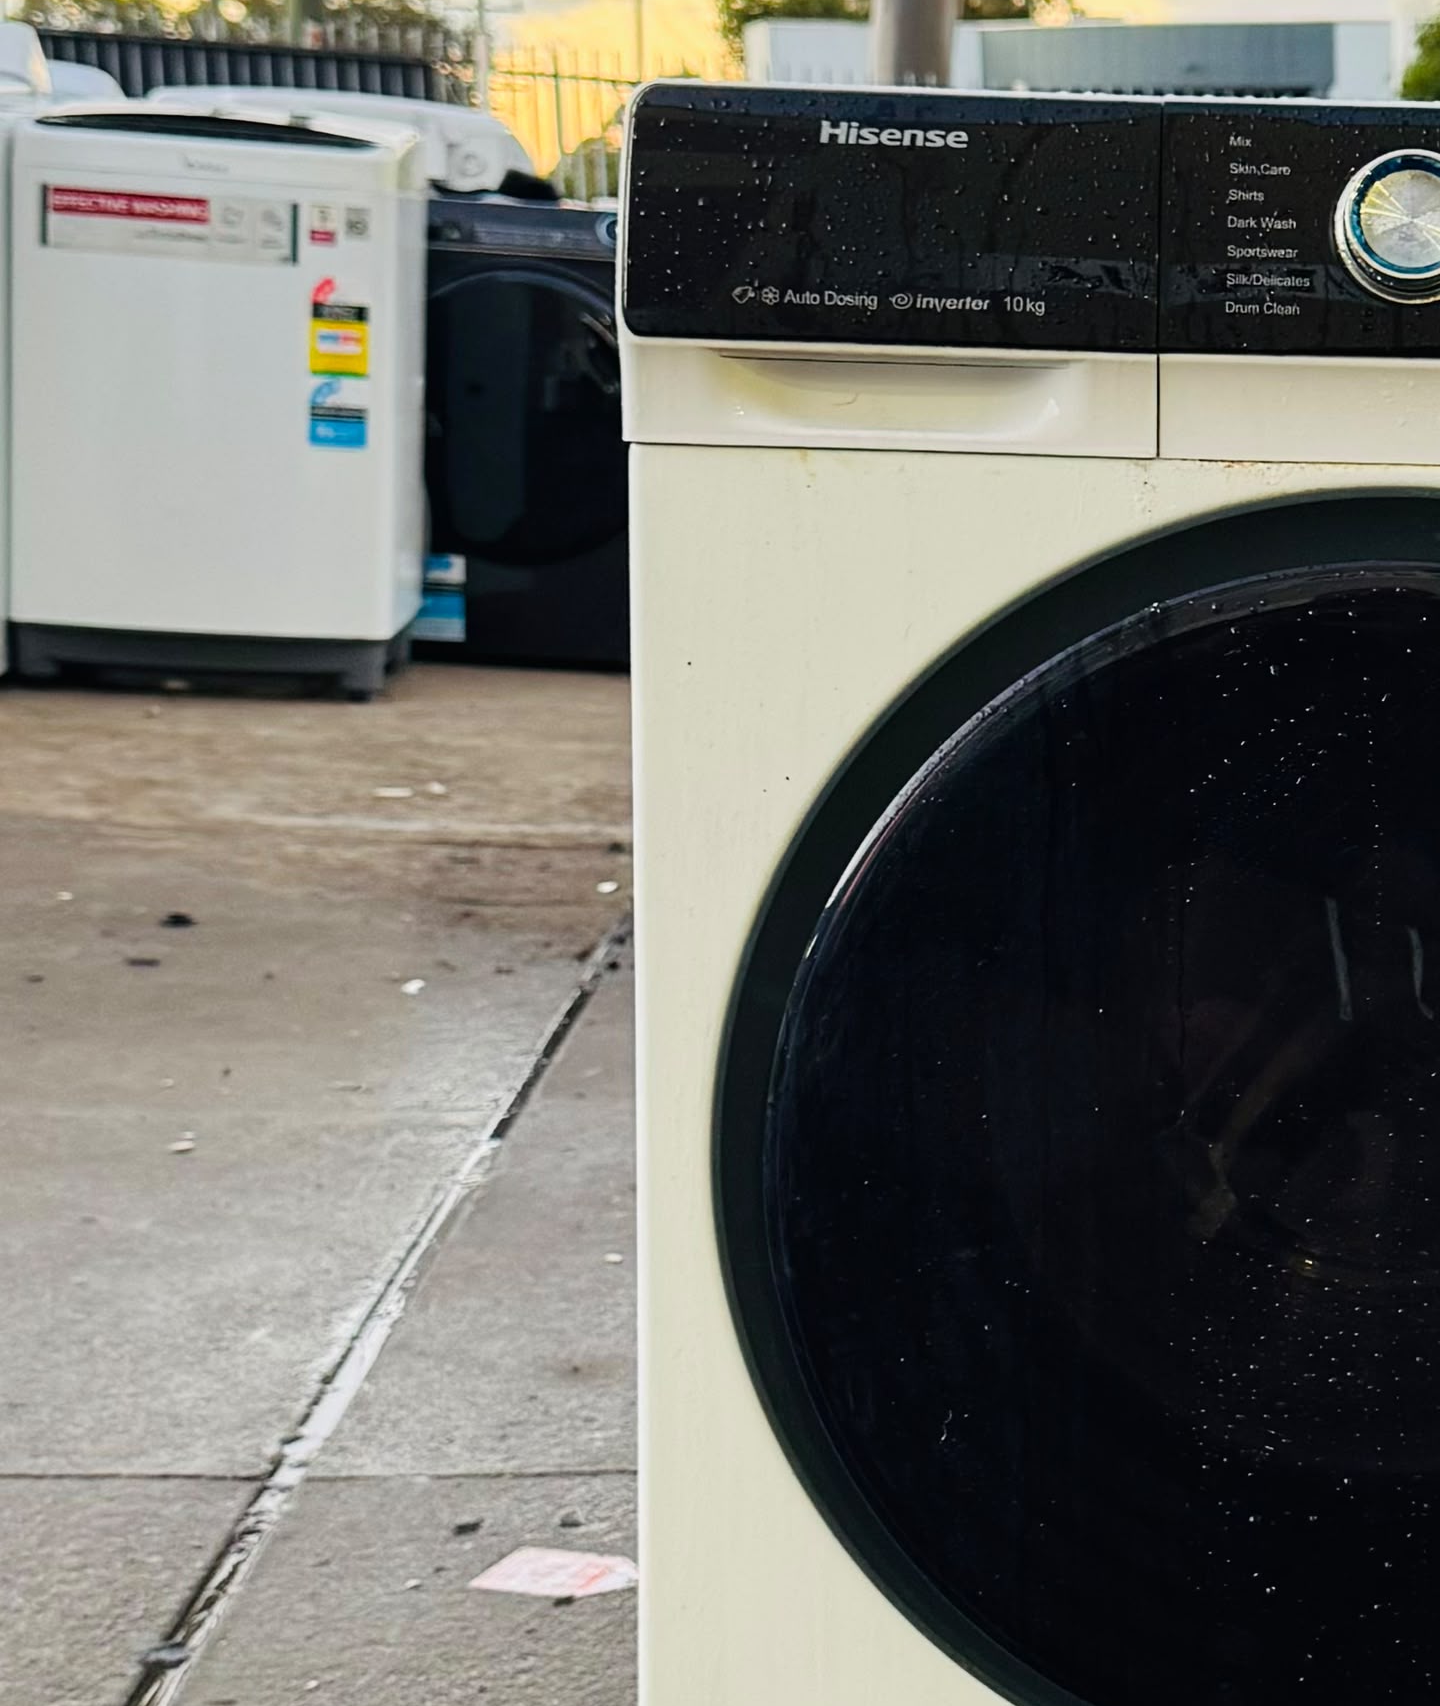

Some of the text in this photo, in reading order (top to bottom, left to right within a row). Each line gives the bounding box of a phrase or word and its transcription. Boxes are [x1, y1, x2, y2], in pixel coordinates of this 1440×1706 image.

[819, 120, 969, 149] Hisense
[1228, 136, 1253, 147] Mix
[1229, 162, 1291, 176] Skin Care
[1228, 188, 1265, 202] Shirts
[1227, 215, 1297, 230] Dark Wash
[1227, 244, 1299, 259] Sportswear
[1226, 273, 1311, 287] Silk/Delicates
[783, 289, 821, 306] Auto
[824, 291, 879, 311] Dosing
[1225, 301, 1301, 316] Drum Clean
